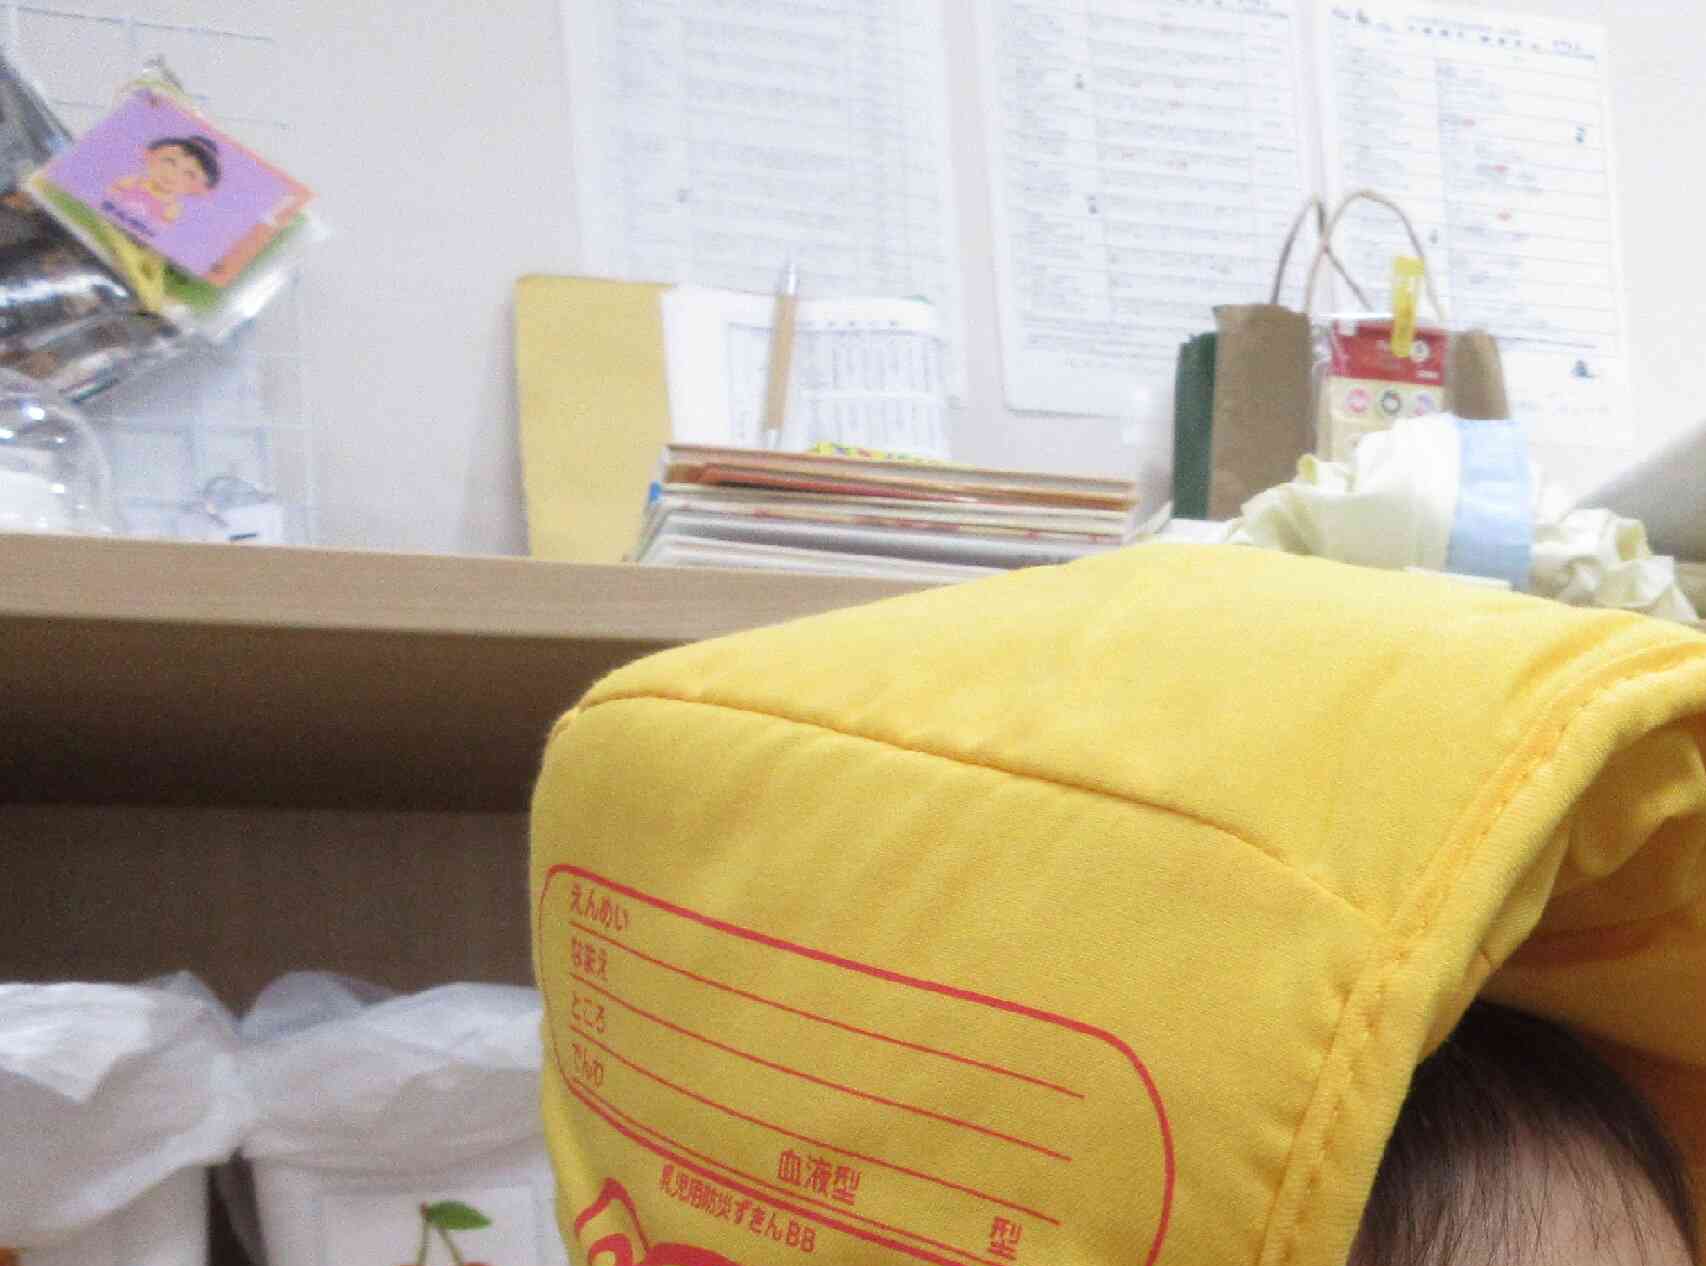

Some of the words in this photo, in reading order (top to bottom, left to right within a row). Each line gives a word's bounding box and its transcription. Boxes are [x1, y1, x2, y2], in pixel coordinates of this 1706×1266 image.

[571, 883, 630, 931] えんめい
[571, 936, 608, 979] なまえ
[571, 990, 608, 1033] ところ
[778, 1149, 861, 1206] 血液型
[988, 1216, 1023, 1260] 型
